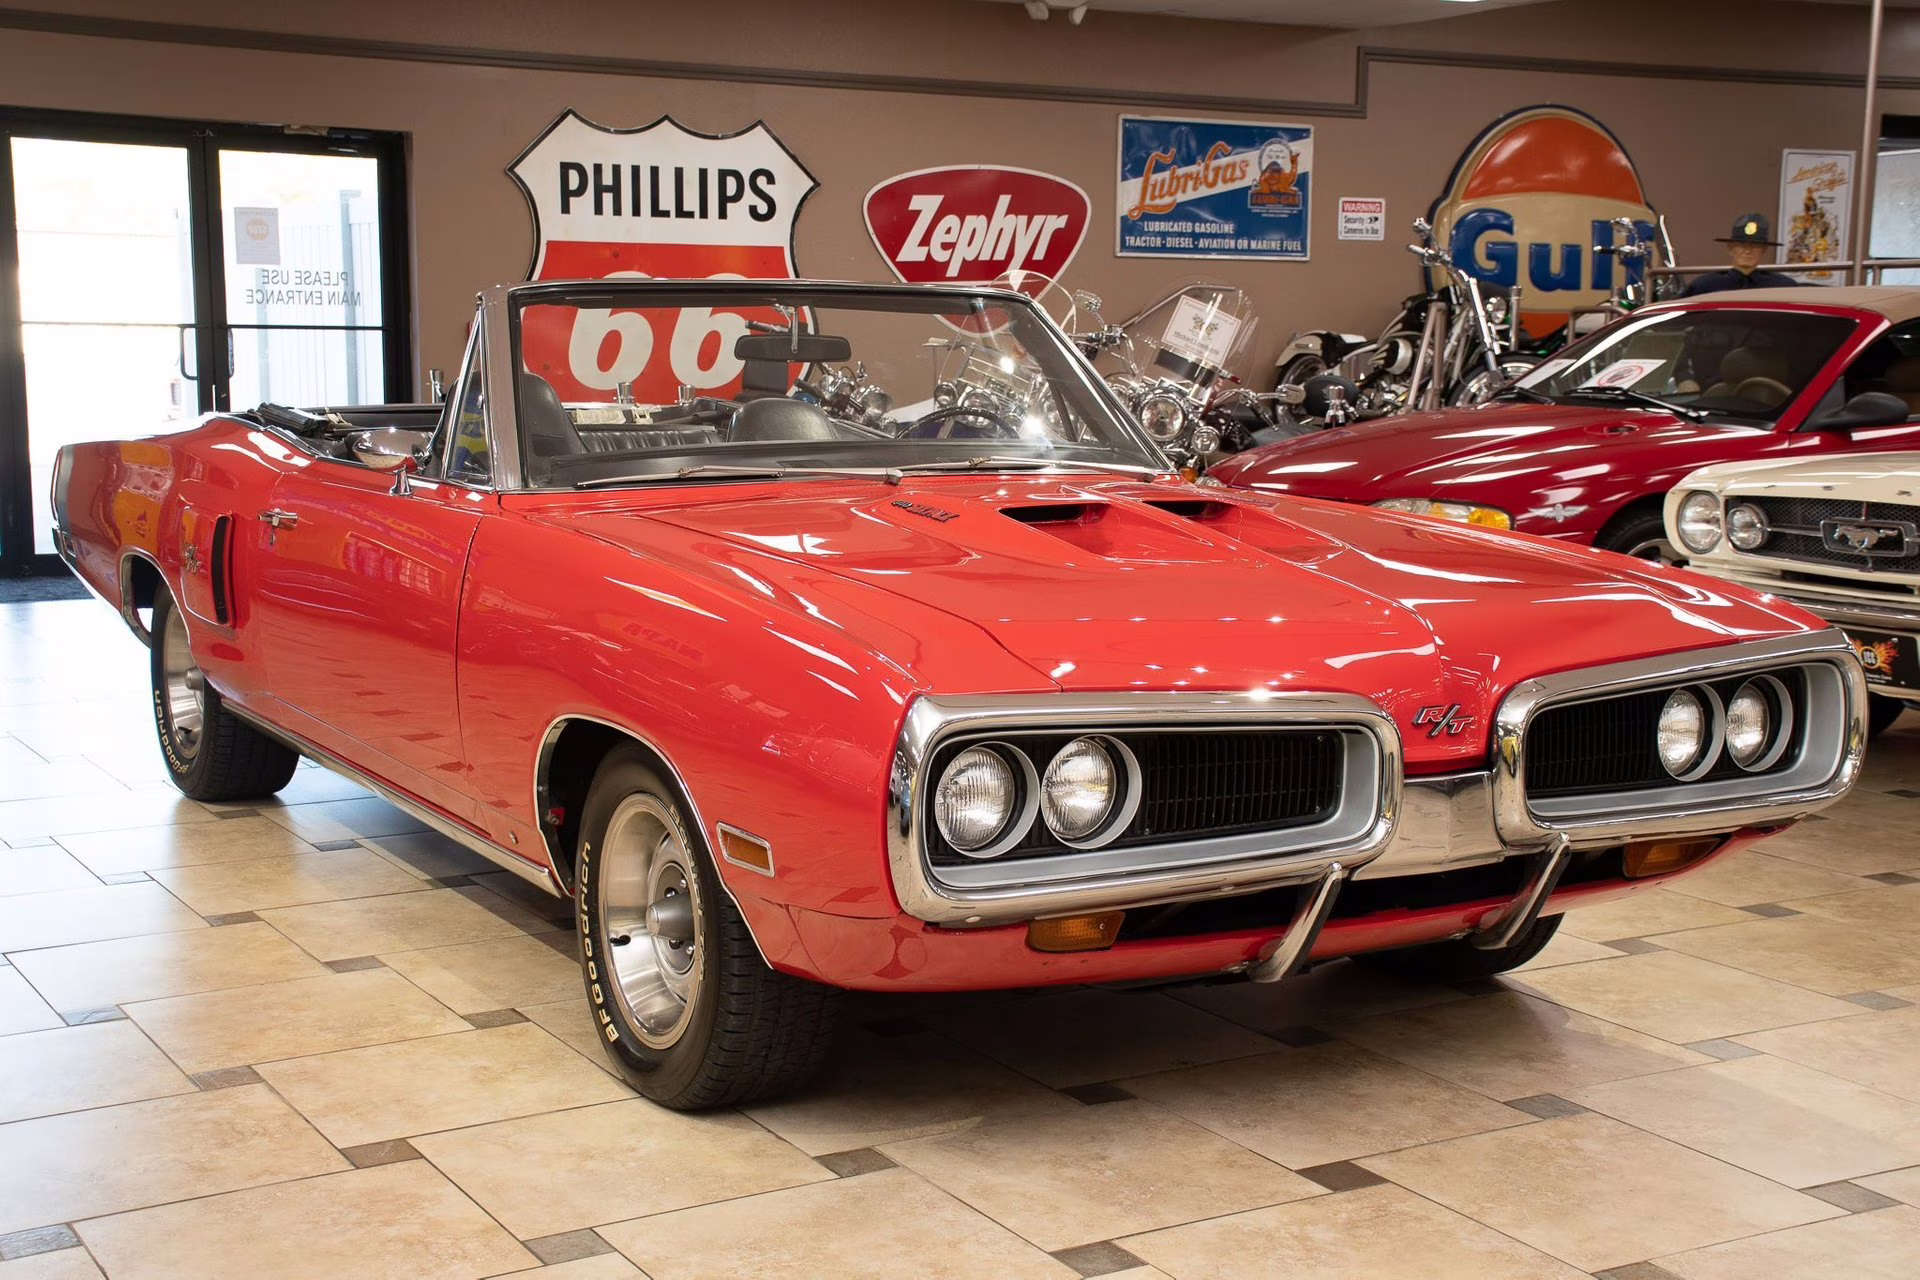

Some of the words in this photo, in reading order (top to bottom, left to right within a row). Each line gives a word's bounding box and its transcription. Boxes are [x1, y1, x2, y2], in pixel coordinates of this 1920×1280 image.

[559, 161, 777, 222] PHILLIPS
[1344, 202, 1381, 212] WARNING
[895, 194, 1069, 279] Zephyr
[1144, 221, 1193, 233] LUBRICATED
[1194, 222, 1235, 234] GASOLINE
[1236, 239, 1249, 249] OR
[1250, 240, 1281, 250] MARINE
[1283, 240, 1302, 251] FUEL
[1449, 208, 1656, 292] Gulf
[568, 271, 752, 391] 66
[1412, 705, 1475, 736] R/T
[579, 841, 620, 1043] BFGoodrich
